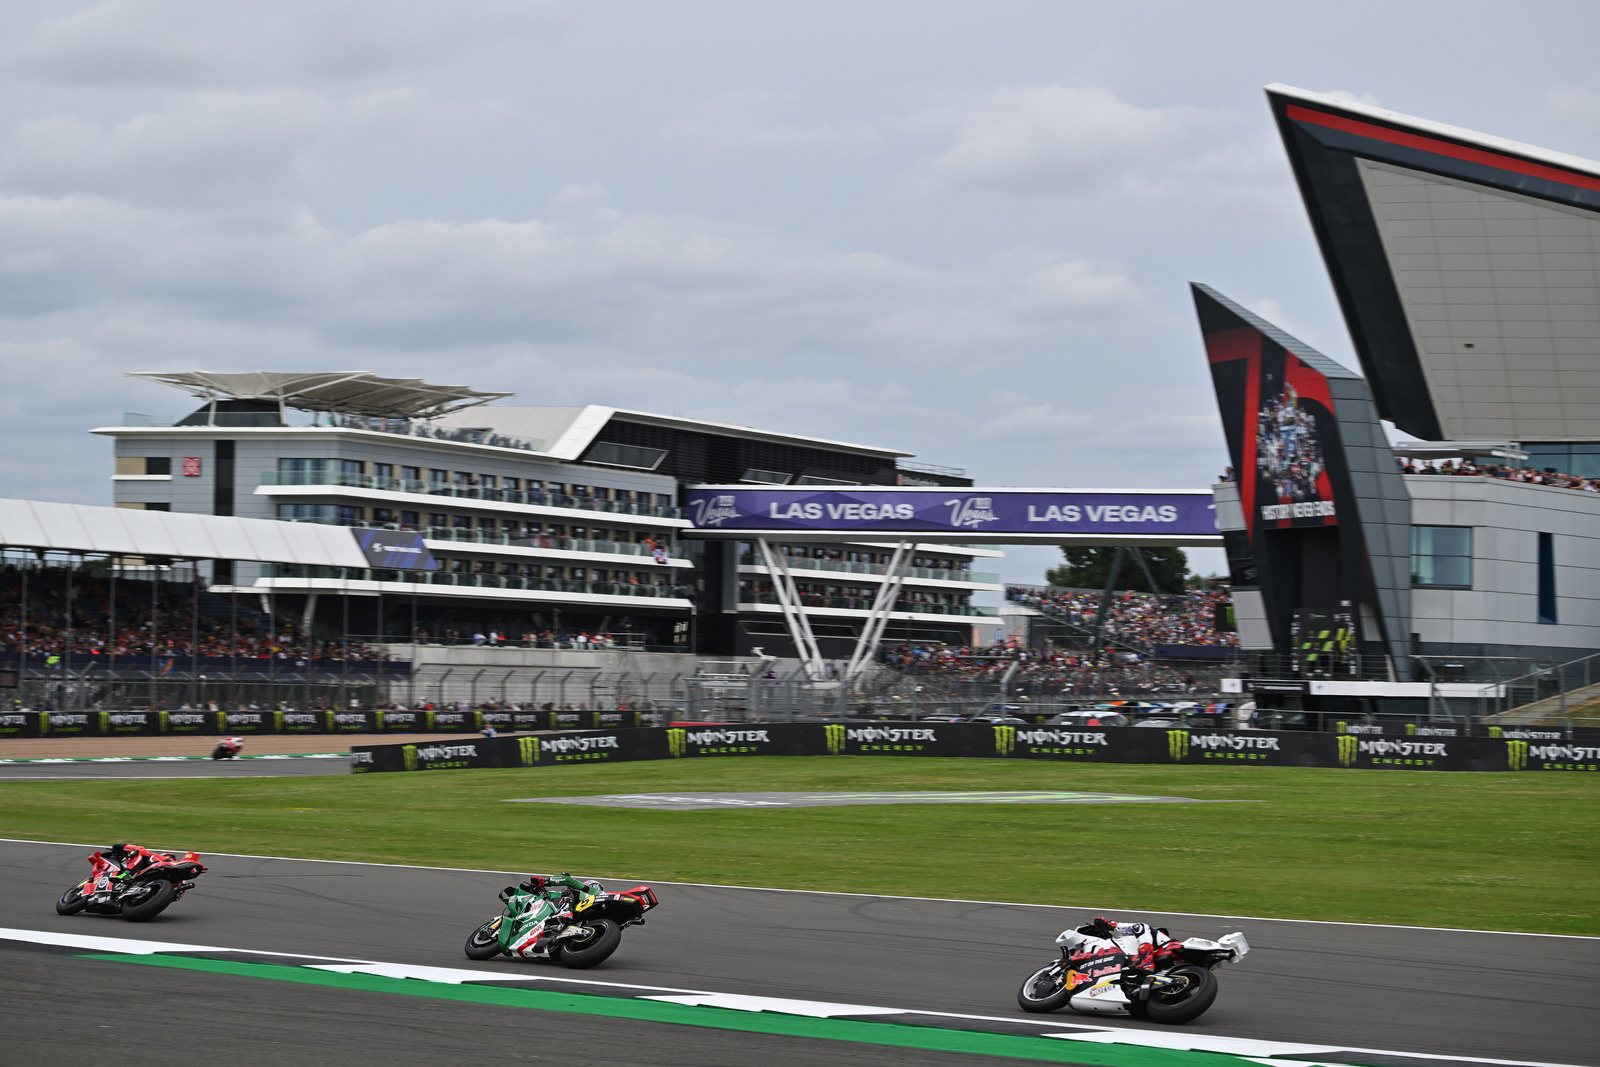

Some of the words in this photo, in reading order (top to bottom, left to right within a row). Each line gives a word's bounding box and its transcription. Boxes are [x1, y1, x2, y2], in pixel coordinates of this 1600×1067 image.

[770, 503, 822, 519] LAS
[827, 503, 914, 519] VEGAS
[1027, 506, 1081, 521] LAS
[1084, 506, 1177, 522] VEGAS
[686, 729, 771, 746] MONSTER
[847, 727, 938, 743] MONSTER
[1016, 729, 1109, 746] MONSTER
[1190, 733, 1281, 750] MONSTER
[540, 736, 619, 753] MONSTER
[699, 747, 760, 755] ENERGY
[860, 744, 924, 752] ENERGY
[1030, 747, 1094, 755] ENERGY
[1359, 738, 1448, 757] MONSTER
[1529, 743, 1600, 761] MONST
[417, 745, 477, 761] MONSTER
[555, 752, 609, 761] ENERGY
[1203, 751, 1268, 760] ENERGY
[1371, 757, 1434, 766] ENERGY
